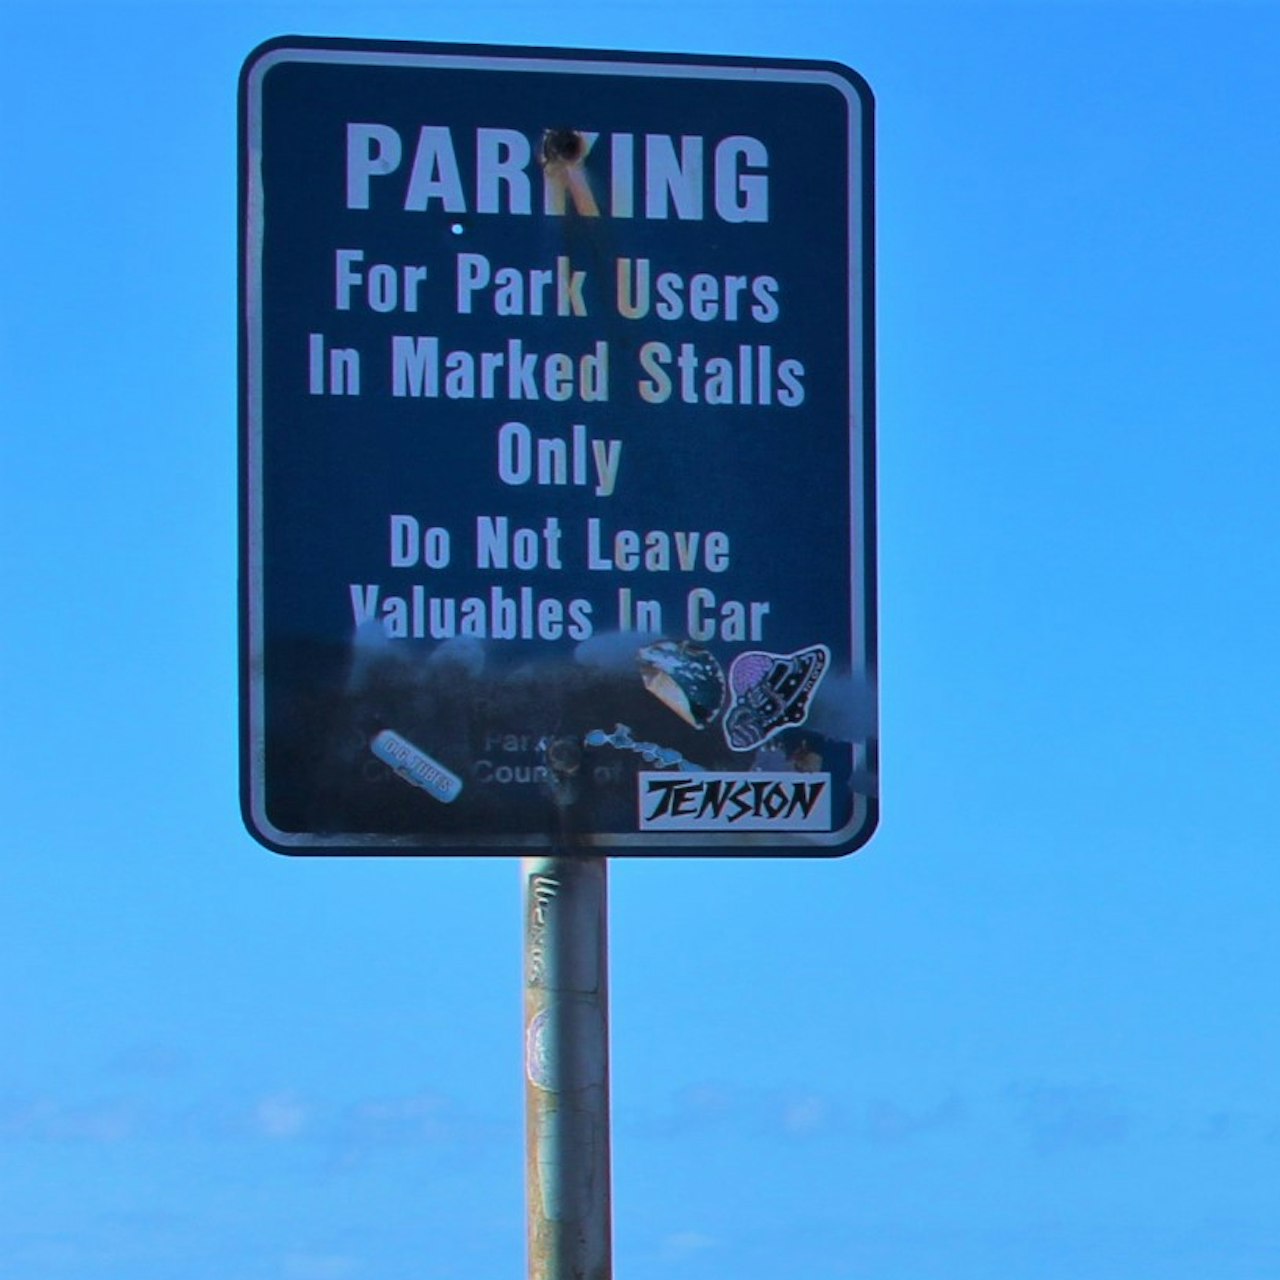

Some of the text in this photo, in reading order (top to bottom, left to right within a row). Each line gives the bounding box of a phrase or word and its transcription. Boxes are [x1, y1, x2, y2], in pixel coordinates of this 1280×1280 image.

[346, 123, 770, 222] PARKING
[335, 249, 780, 324] For Park Users
[308, 333, 806, 406] In Marked Stalls
[497, 422, 622, 497] Only
[389, 514, 730, 573] Do Not Leave
[350, 584, 770, 642] Valuables In Car
[646, 777, 826, 825] TENSION
